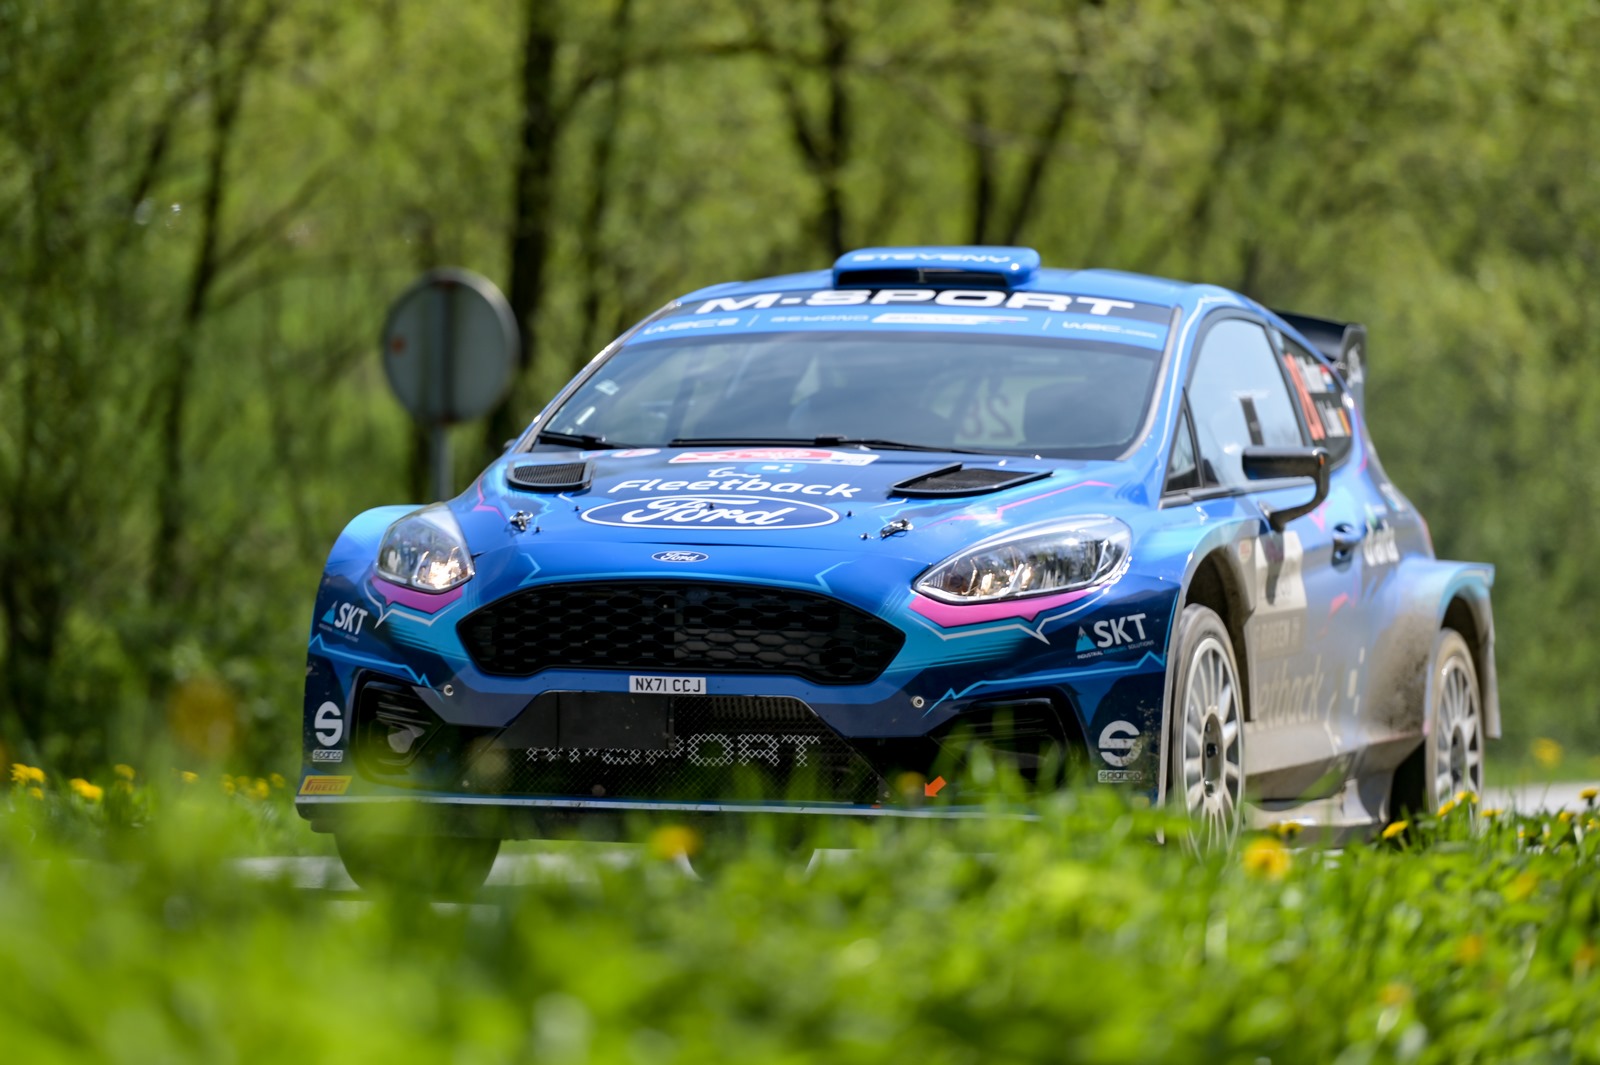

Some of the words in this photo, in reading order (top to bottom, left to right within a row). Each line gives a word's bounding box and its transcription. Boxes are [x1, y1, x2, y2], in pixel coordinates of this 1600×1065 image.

[694, 289, 1135, 317] M-SPORT
[607, 477, 862, 498] Fleetback
[621, 498, 797, 526] Ford
[661, 551, 699, 563] Ford
[334, 602, 369, 635] SKT
[1093, 612, 1147, 648] SKT
[635, 678, 667, 692] NX71
[672, 679, 701, 693] CCJ
